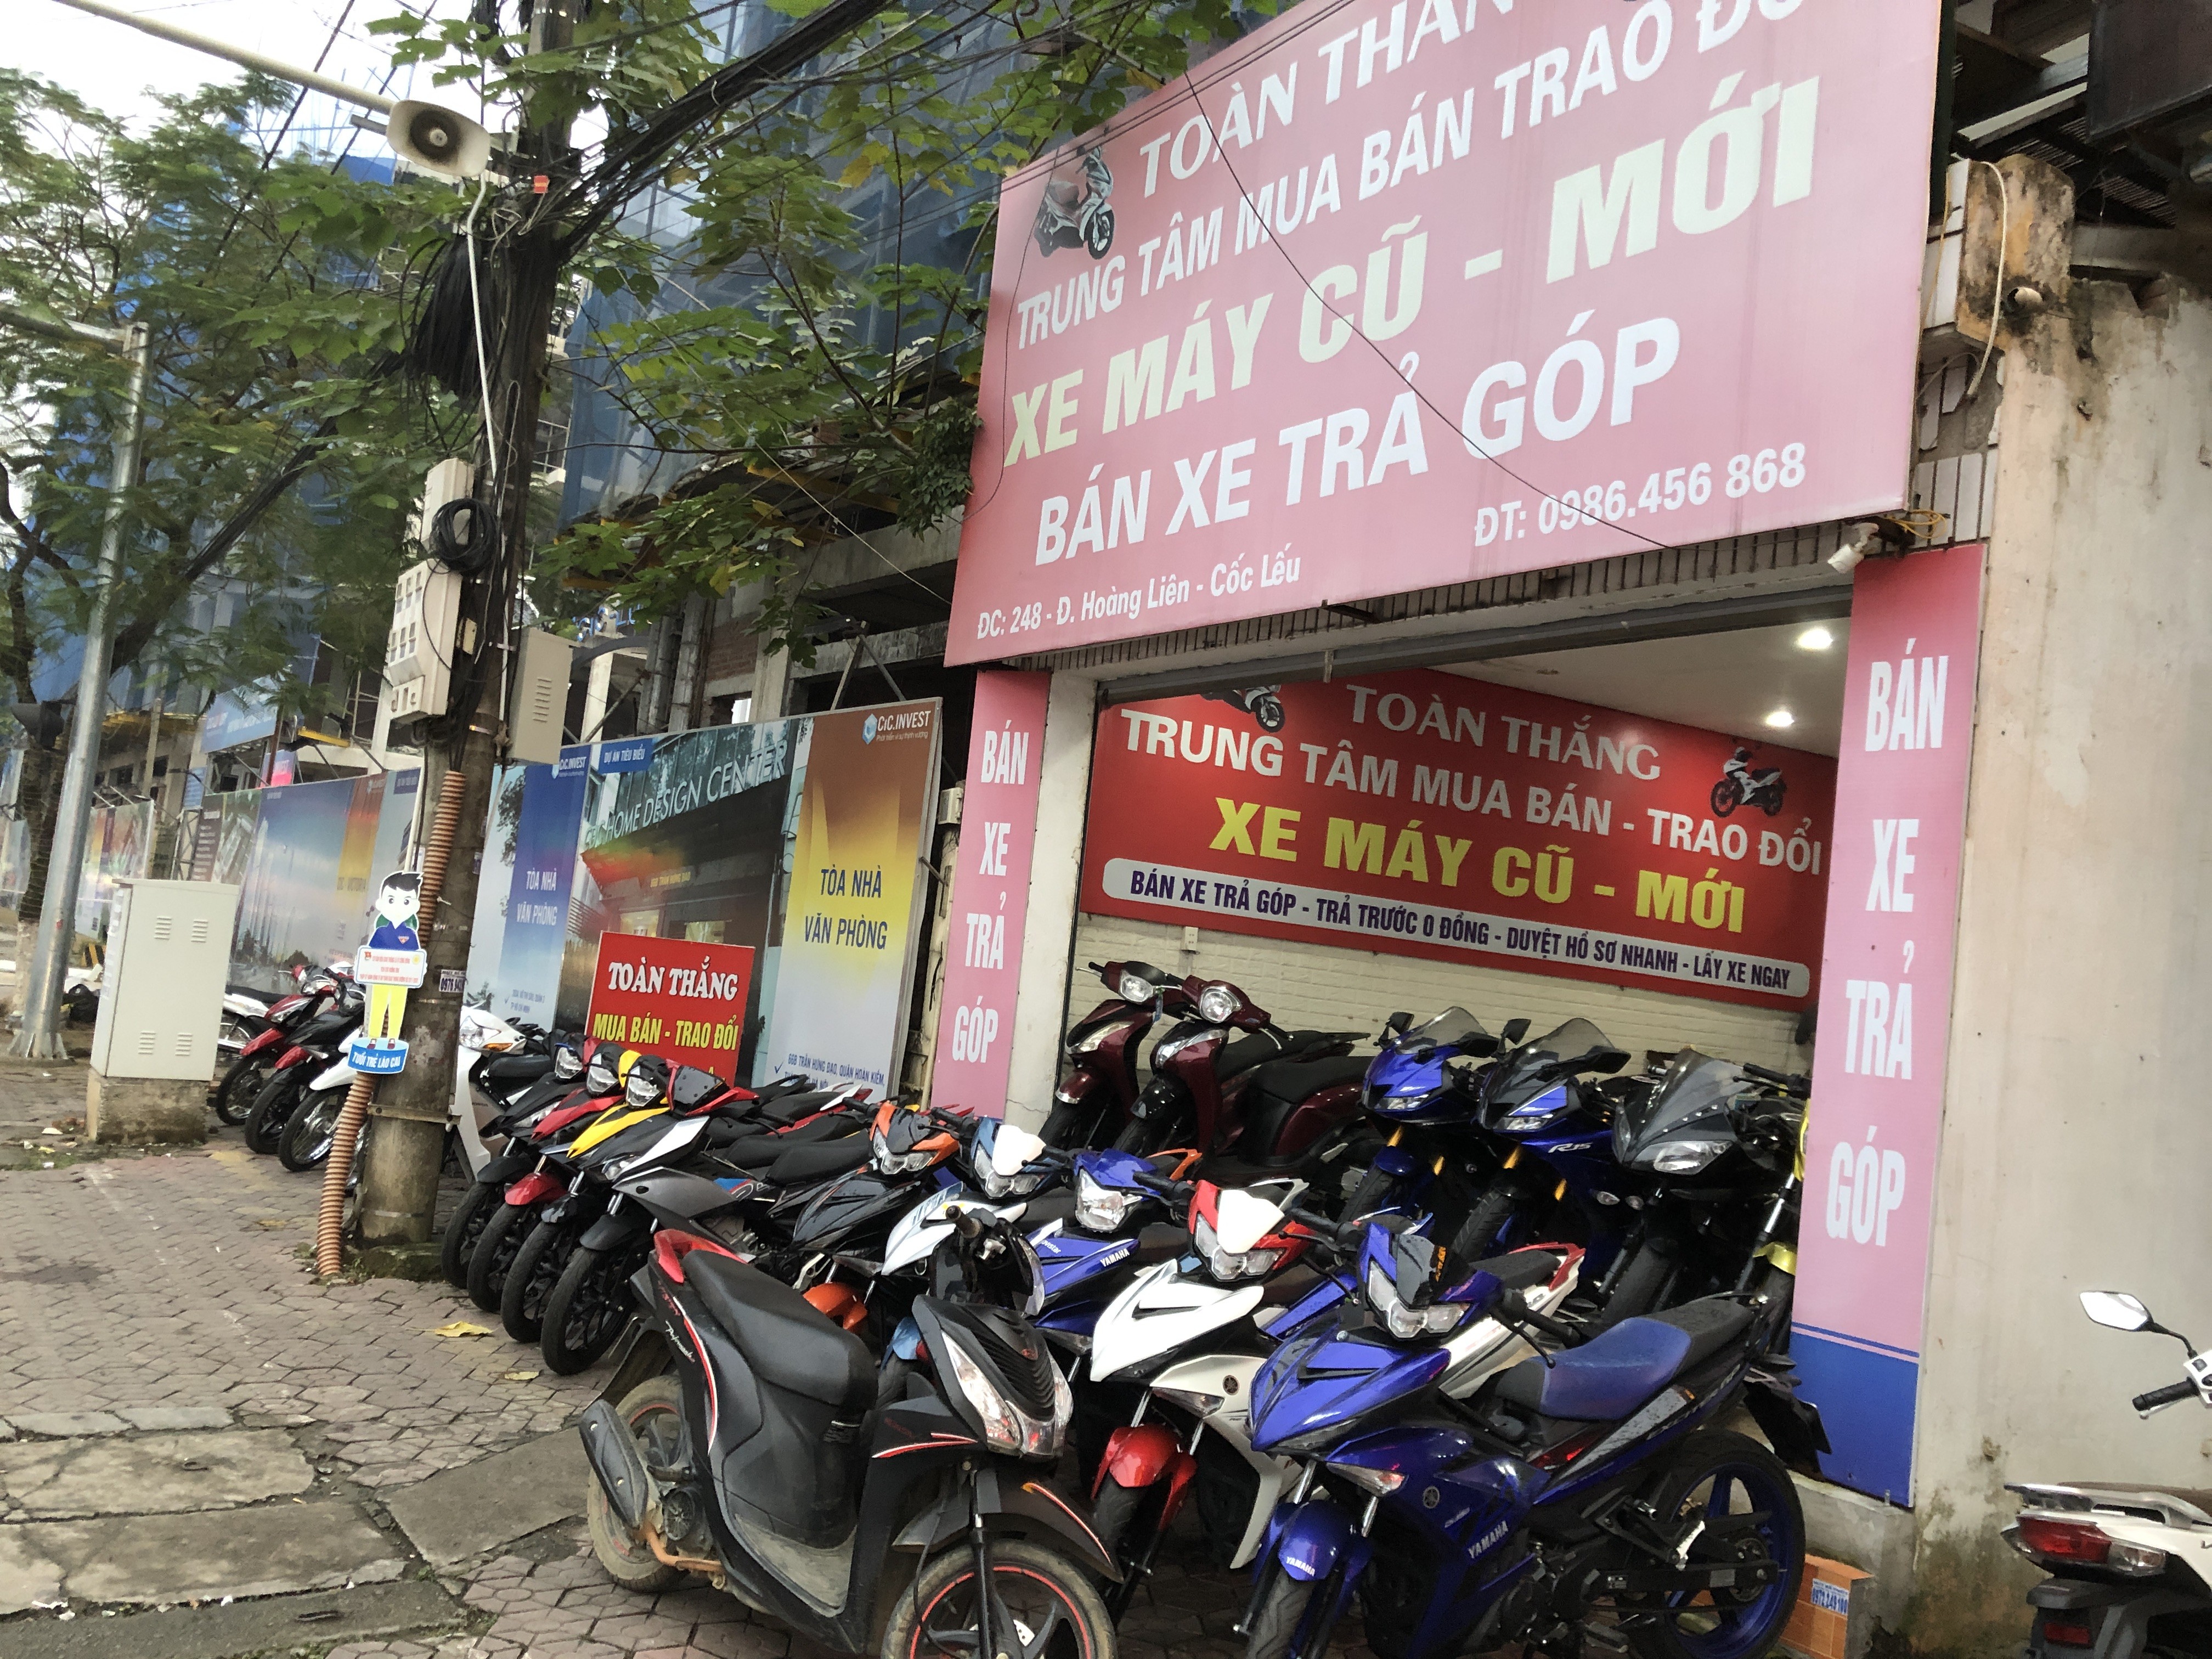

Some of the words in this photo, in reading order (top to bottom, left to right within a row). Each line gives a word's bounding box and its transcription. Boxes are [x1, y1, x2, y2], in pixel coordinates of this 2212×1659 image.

[1139, 61, 1298, 198] TOÀN
[1018, 256, 1125, 349] TRUNG
[1138, 212, 1223, 297] TÂM
[1234, 154, 1341, 255] MUA
[1359, 87, 1474, 201] BÁN
[1494, 0, 1673, 139] TRAO
[1003, 369, 1084, 466] XE
[1102, 292, 1274, 434] MÁY
[1299, 215, 1427, 363] CŨ
[1547, 71, 1819, 284] MỚI
[1035, 464, 1150, 566] BÁN
[1165, 438, 1256, 535] XE
[1279, 351, 1428, 506] TRẢ
[1462, 309, 1680, 460] GÓP
[1474, 499, 1526, 546] ĐT:
[1538, 462, 1712, 534] 0986.456
[1725, 442, 1806, 499] 868
[977, 611, 1007, 640] ĐC:
[1010, 602, 1041, 634] 248
[1056, 596, 1075, 627] Đ.
[1081, 582, 1142, 620] Hoàng
[1147, 573, 1189, 610] Liên
[1210, 556, 1253, 596] Cốc
[1347, 685, 1485, 746] TOÀN
[1501, 715, 1660, 780] THẮNG
[1865, 638, 1948, 752] BÁN
[605, 803, 641, 841] HOME
[642, 776, 702, 828] DESIGN
[707, 740, 788, 802] CENTER
[980, 720, 1029, 785] BÁN
[1121, 709, 1283, 776] TRUNG
[1300, 740, 1398, 797] TÂM
[1412, 764, 1511, 818] MUA
[1526, 784, 1612, 836] BÁN
[1647, 809, 1748, 860] TRAO
[1758, 817, 1821, 874] ĐỔI
[526, 867, 540, 890] TÒA
[540, 867, 557, 891] NHÀ
[821, 864, 845, 897] TÒA
[851, 863, 882, 899] NHÀ
[979, 822, 1011, 877] XE
[1209, 797, 1301, 862] XE
[1324, 820, 1472, 887] MÁY
[1492, 844, 1574, 904] CŨ
[1635, 867, 1745, 933] MỚI
[1865, 819, 1918, 912] XE
[517, 901, 532, 924] VĂN
[532, 901, 557, 926] PHÒNG
[804, 916, 832, 945] VĂN
[836, 913, 887, 951] PHÒNG
[965, 891, 1005, 970] TRẢ
[1131, 869, 1175, 899] BÁN
[1180, 878, 1206, 904] XE
[1214, 880, 1249, 911] TRẢ
[1256, 887, 1297, 916] GÓP
[1317, 895, 1350, 924] TRẢ
[1358, 903, 1417, 934] TRƯỚC
[1439, 912, 1488, 945] ĐỒNG
[1506, 927, 1561, 960] DUYỆT
[1566, 929, 1588, 958] HỒ
[1594, 939, 1617, 963] SƠ
[1621, 944, 1677, 973] NHANH
[1694, 951, 1720, 980] LẤY
[1726, 962, 1746, 983] XE
[1751, 964, 1790, 990] NGAY
[608, 956, 665, 994] TOÀN
[669, 956, 738, 1001] THẮNG
[1845, 940, 1914, 1080] TRẢ
[390, 1056, 401, 1068] CAI
[592, 1013, 627, 1042] MUA
[630, 1012, 662, 1044] BÁN
[675, 1020, 711, 1048] TRAO
[713, 1014, 738, 1050] ĐỔI
[952, 996, 998, 1063] GÓP
[1825, 1126, 1905, 1246] GÓP
[1100, 1248, 1130, 1267] YAMAHA
[1286, 1556, 1316, 1577] YAMAHA
[1468, 1520, 1509, 1559] YAMAHA
